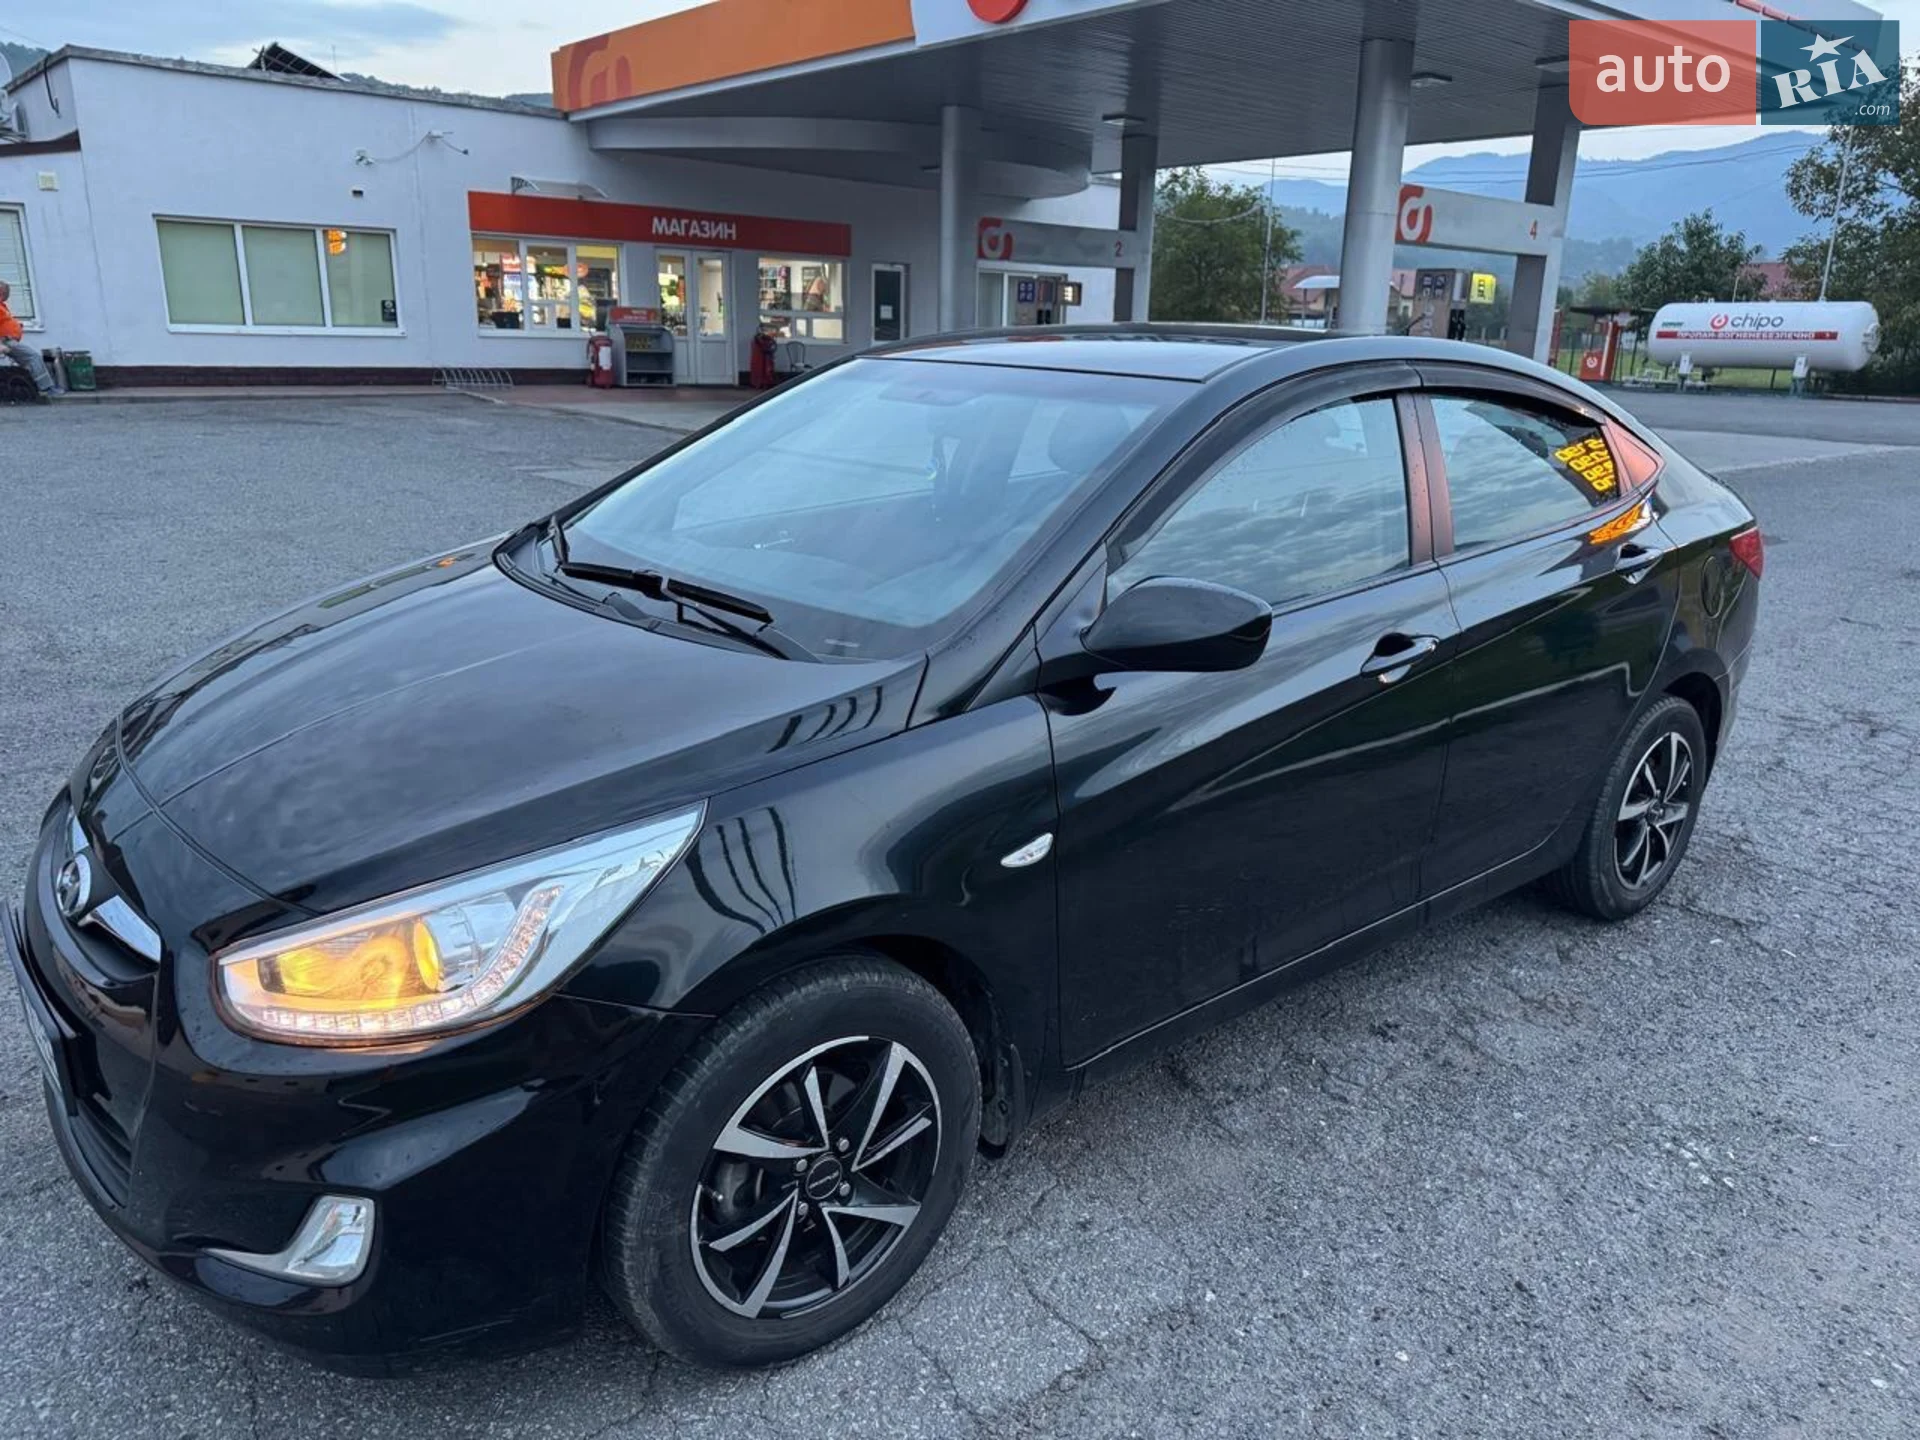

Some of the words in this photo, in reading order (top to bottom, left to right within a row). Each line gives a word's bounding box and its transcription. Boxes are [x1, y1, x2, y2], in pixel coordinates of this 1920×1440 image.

[651, 215, 737, 241] МАГАЗИН
[1529, 219, 1538, 241] 4
[1114, 240, 1123, 257] 2
[1730, 313, 1784, 331] chipo
